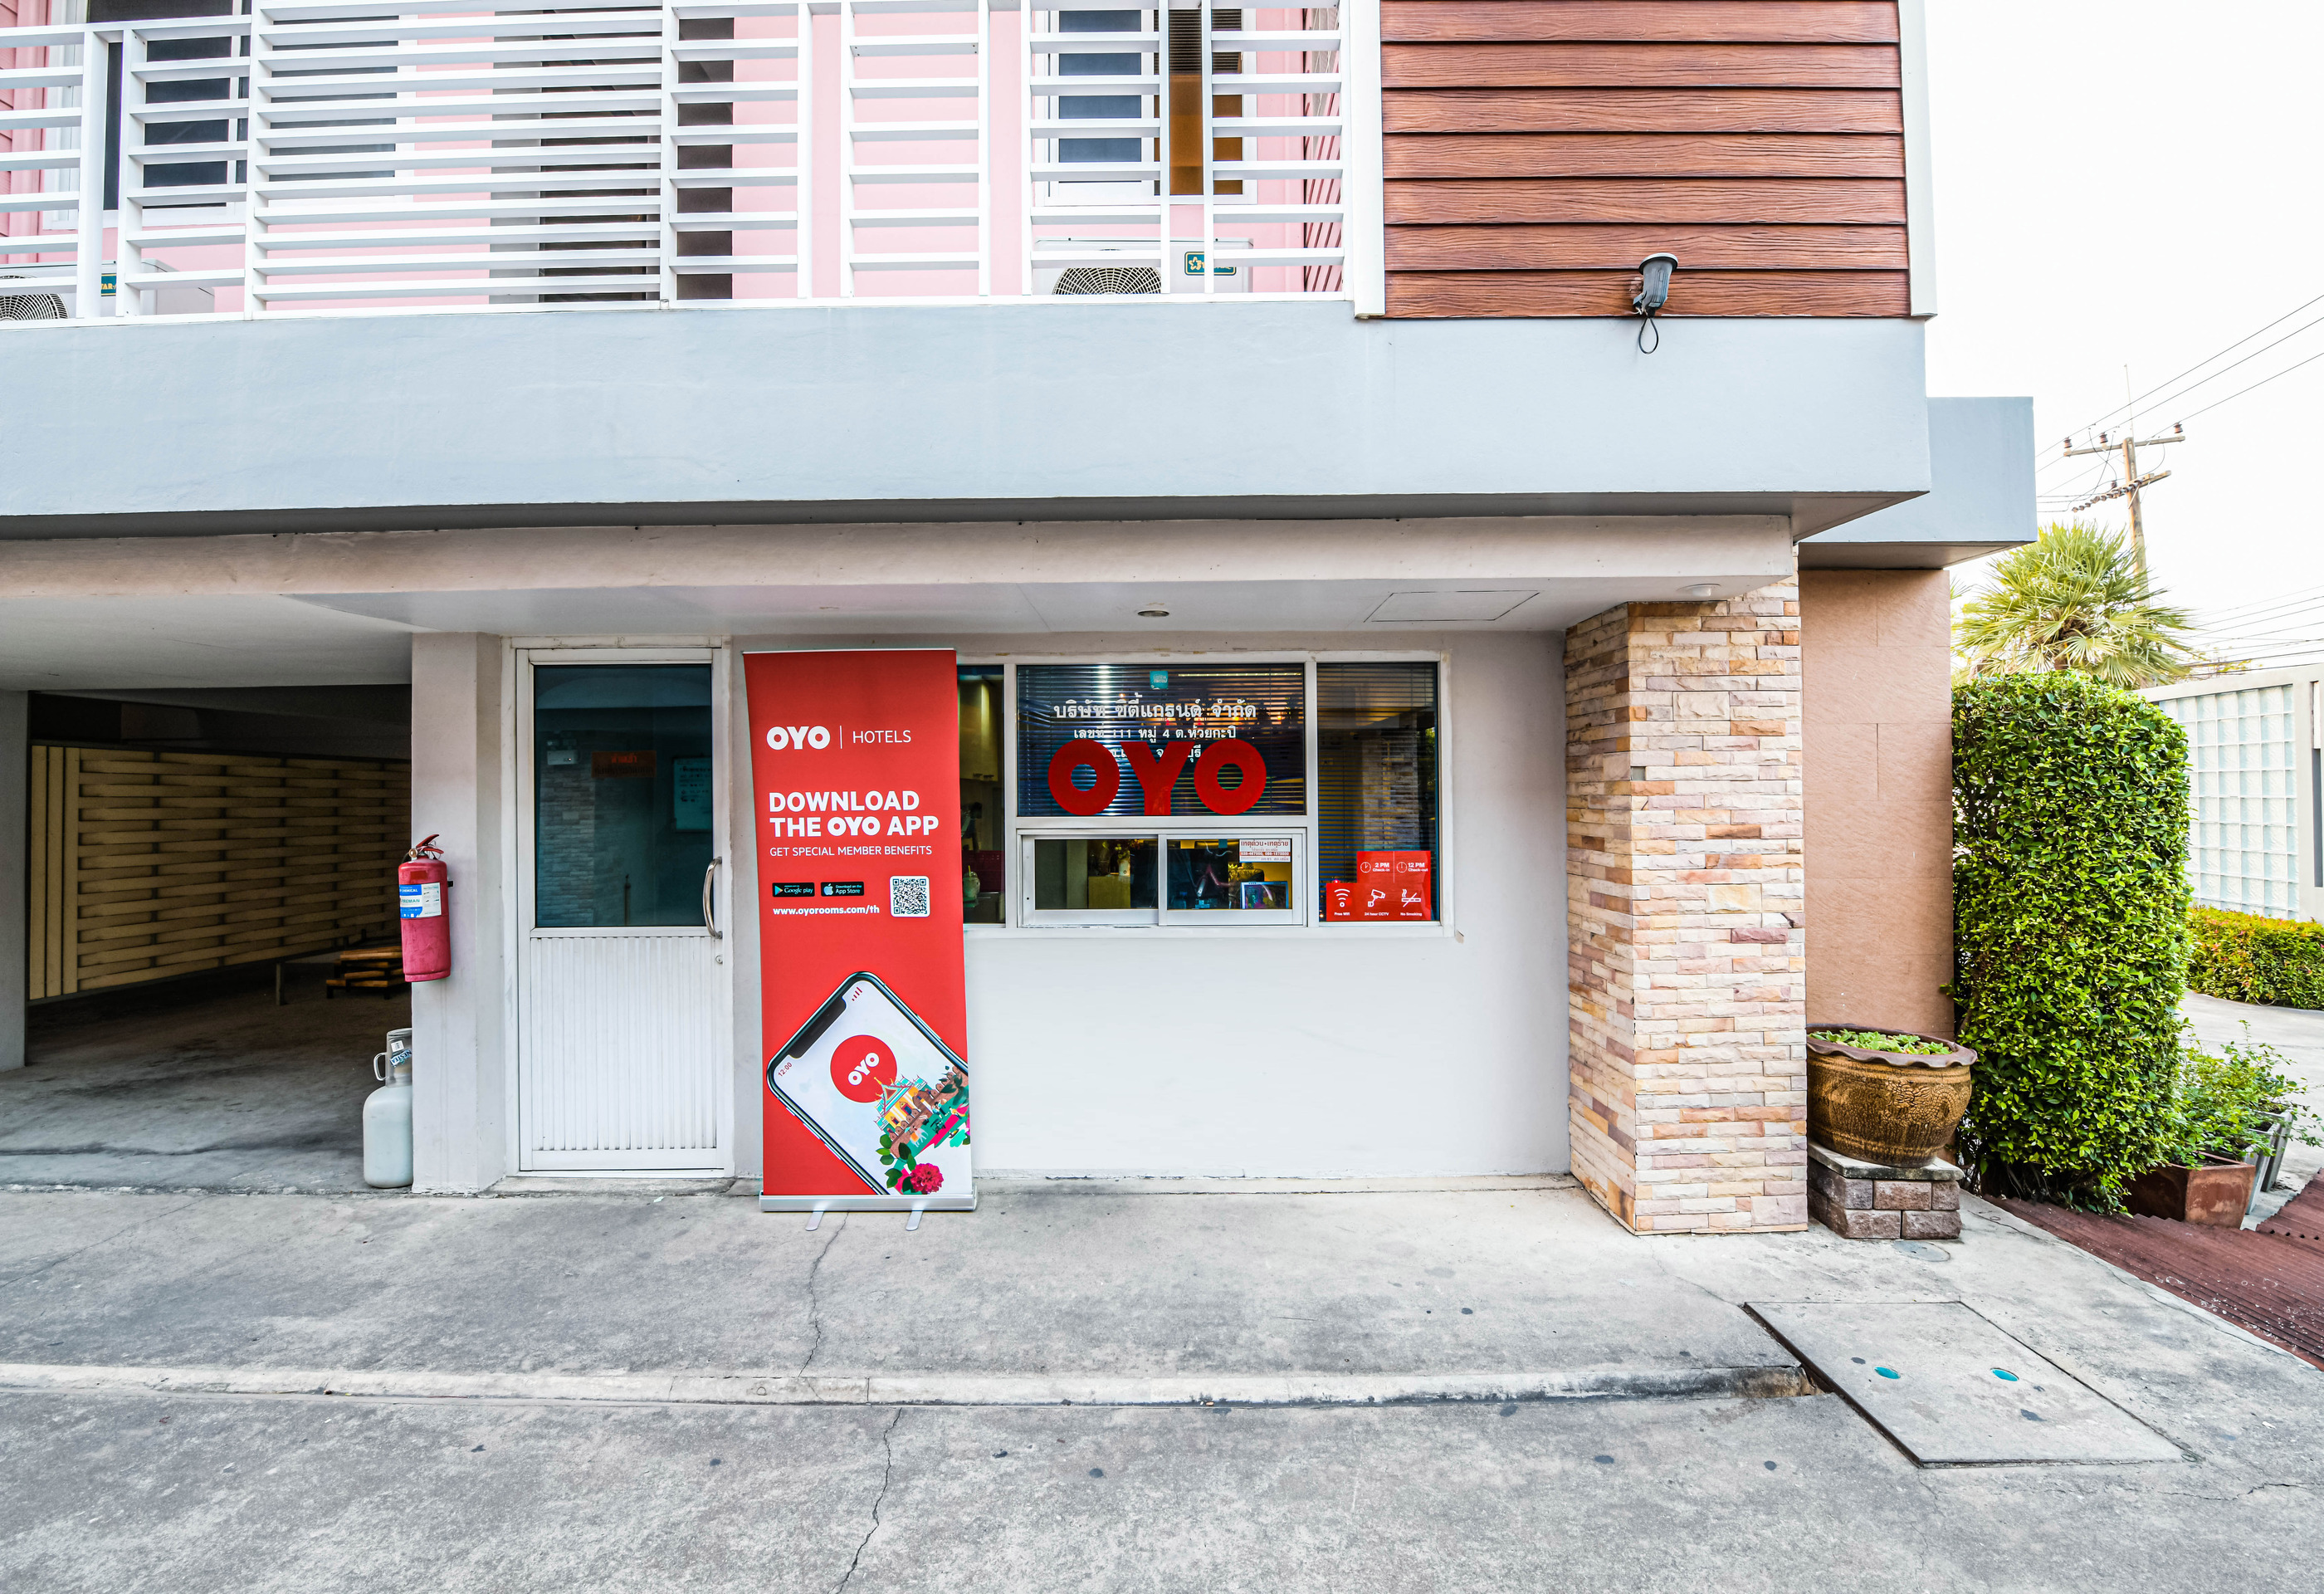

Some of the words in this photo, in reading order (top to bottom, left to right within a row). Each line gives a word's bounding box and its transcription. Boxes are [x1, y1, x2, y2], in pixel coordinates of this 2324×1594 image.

[1211, 698, 1257, 717] จำกัด
[766, 726, 831, 751] OYO
[852, 730, 912, 744] HOTELS
[1138, 726, 1157, 743] หมู่
[1162, 730, 1170, 738] 4
[1047, 738, 1267, 816] OYO
[769, 790, 920, 813] DOWNLOAD
[769, 817, 822, 838] THE
[827, 816, 881, 838] OYO
[886, 815, 939, 836] APP
[769, 847, 789, 857] GET
[792, 846, 835, 857] SPECIAL
[837, 846, 882, 856] MEMBER
[884, 845, 932, 856] BENEFITS
[773, 904, 880, 917] www.oyorooms.com/th
[778, 1062, 793, 1077] 12:00
[847, 1052, 880, 1086] OYO
